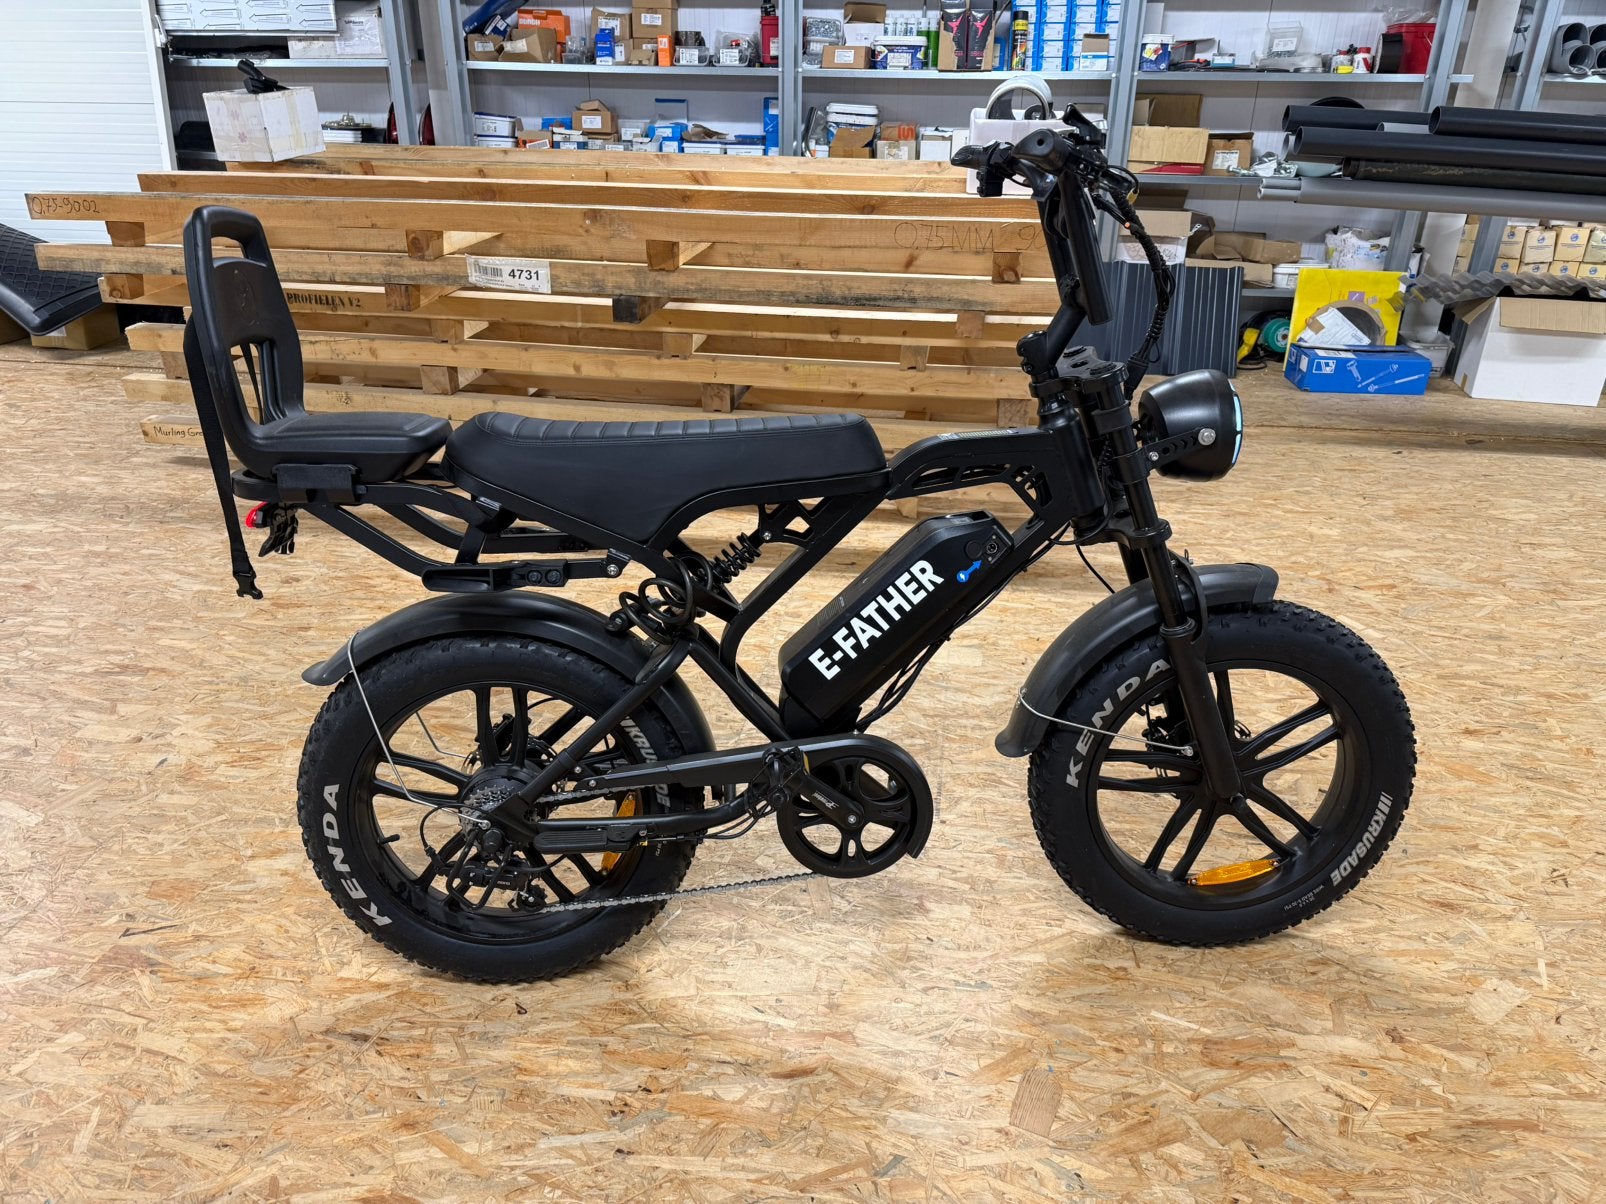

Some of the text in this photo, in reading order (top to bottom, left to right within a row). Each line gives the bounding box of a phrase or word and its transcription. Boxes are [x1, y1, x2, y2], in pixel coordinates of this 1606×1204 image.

[286, 291, 346, 309] PROFIELEN
[508, 268, 540, 281] 4731
[808, 559, 944, 681] E-FATHER
[1065, 658, 1171, 788] KENDA
[322, 783, 393, 926] KENDA
[1330, 808, 1388, 887] KRUSADE
